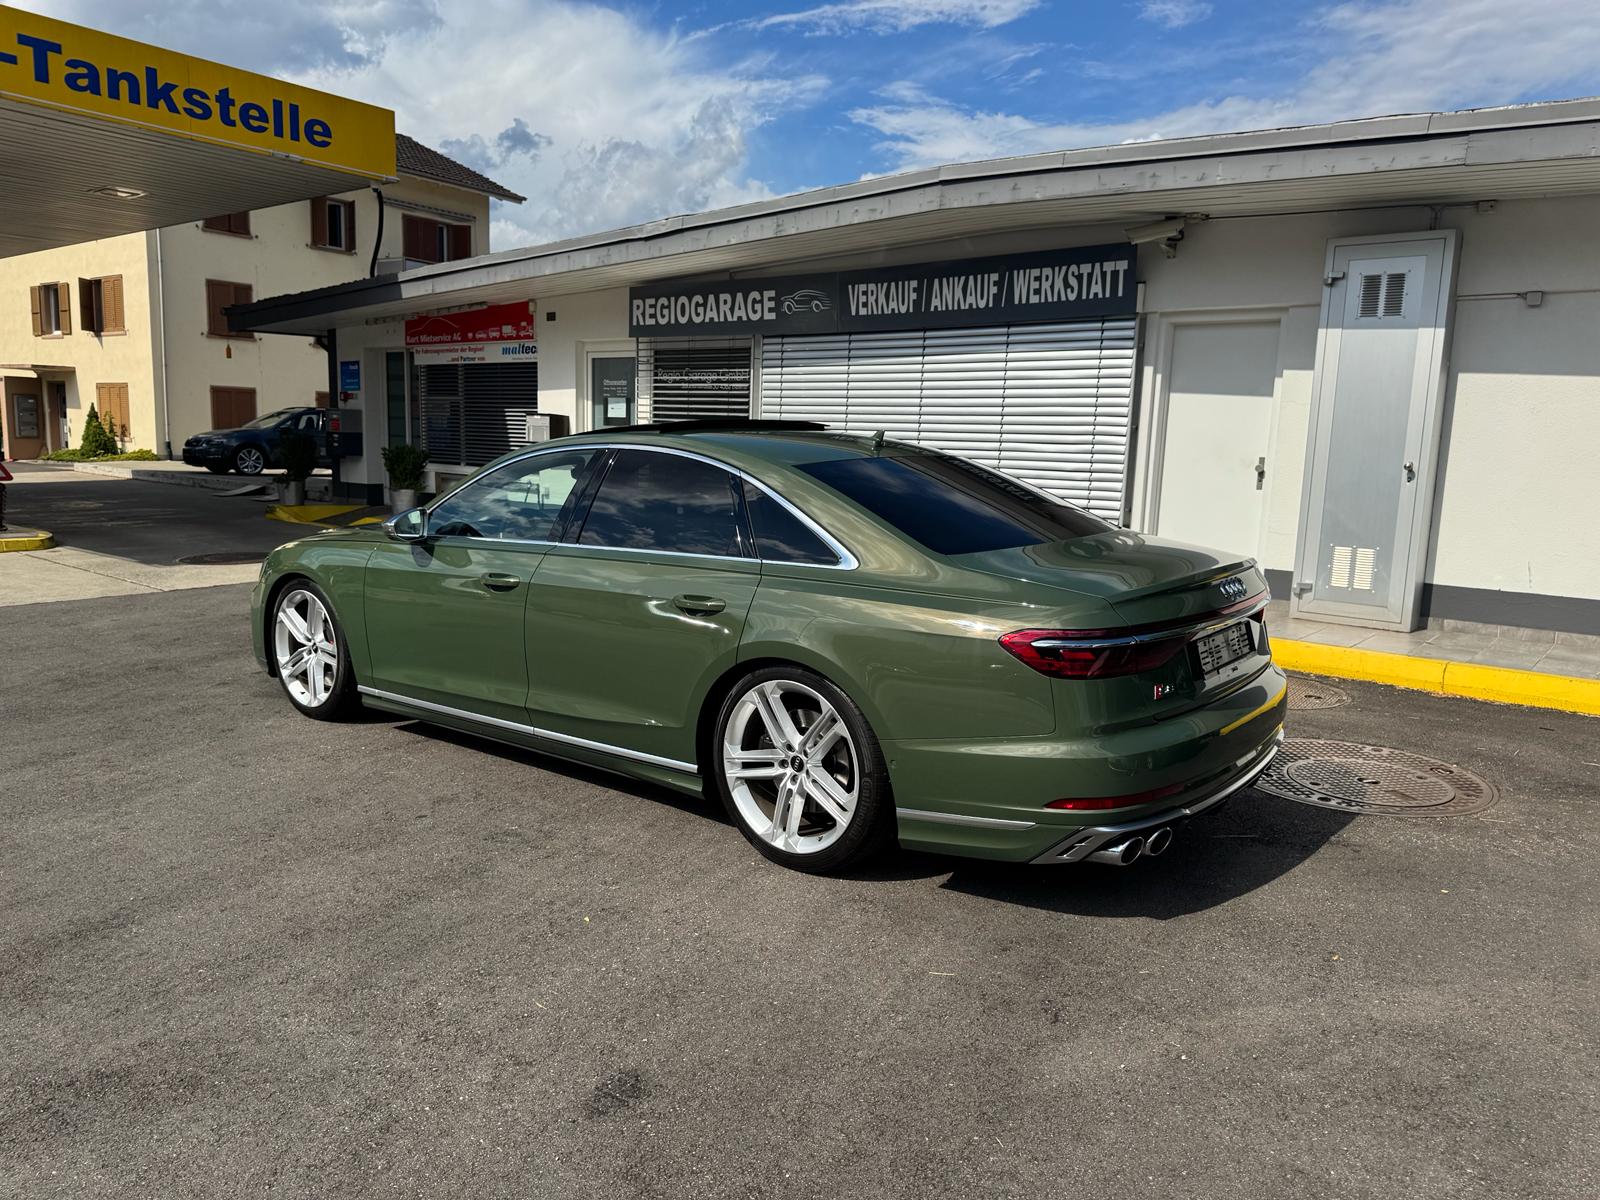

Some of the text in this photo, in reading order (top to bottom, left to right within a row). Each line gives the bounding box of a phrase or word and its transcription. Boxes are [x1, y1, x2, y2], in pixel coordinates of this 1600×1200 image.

[848, 280, 918, 316] VERKAUF
[930, 272, 999, 311] ANKAUF
[1013, 260, 1129, 304] WERKSTATT
[632, 290, 777, 326] REGIOGARAGE
[453, 332, 462, 341] AG
[502, 343, 537, 356] maltec
